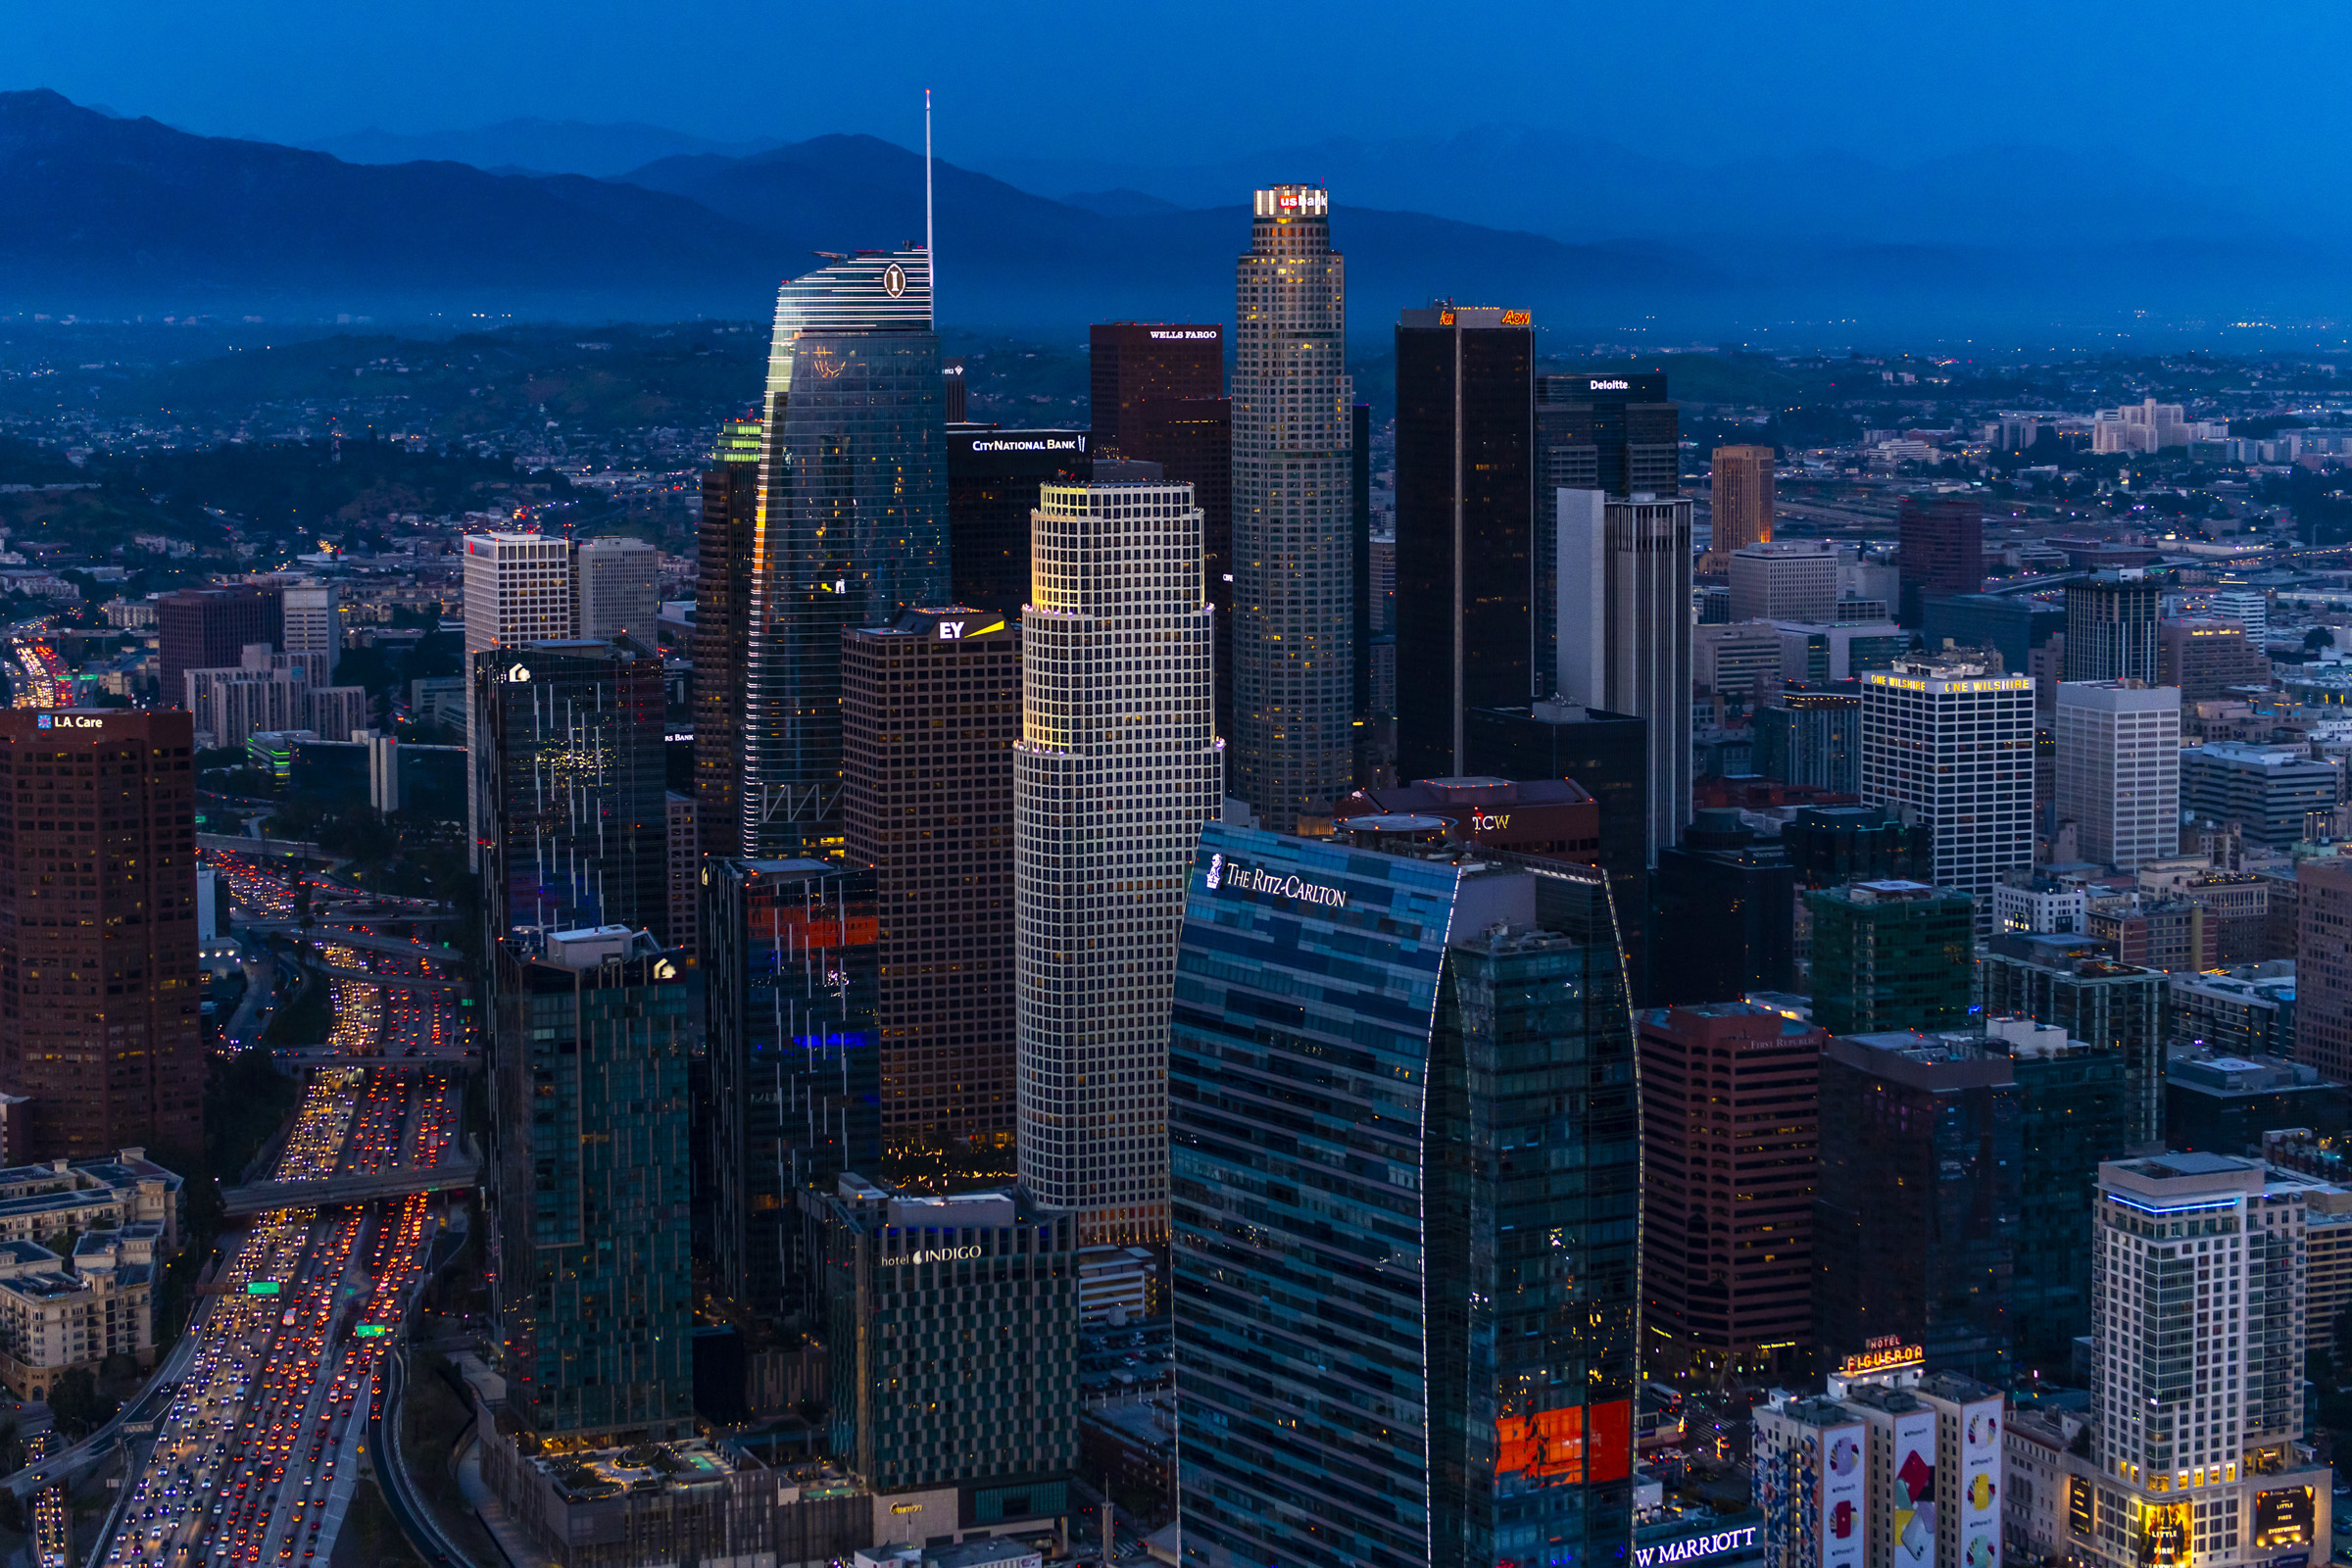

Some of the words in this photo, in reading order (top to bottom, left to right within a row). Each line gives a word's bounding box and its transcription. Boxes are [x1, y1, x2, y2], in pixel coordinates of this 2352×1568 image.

[1501, 310, 1530, 325] AON
[1150, 330, 1184, 339] WELLS
[1185, 330, 1217, 339] FARGO
[1047, 439, 1076, 450] BANK
[939, 621, 964, 640] EY
[1871, 674, 1886, 686] ONE
[1888, 676, 1926, 692] WILSHIRE
[1944, 682, 1968, 693] ONE
[1973, 679, 2030, 692] WILSHIRE
[54, 716, 74, 728] L.A.
[75, 716, 103, 728] Care
[1472, 814, 1510, 830] TCW
[1227, 862, 1251, 888] THE
[1252, 868, 1347, 907] RITZ-CARLTON
[881, 1254, 909, 1267] hotel
[925, 1245, 982, 1262] INDIGO
[1870, 1336, 1901, 1349] HOTEL
[1847, 1346, 1923, 1371] FIGUEROA
[1658, 1527, 1757, 1564] MARRIOTT
[2153, 1546, 2176, 1555] FIRES
